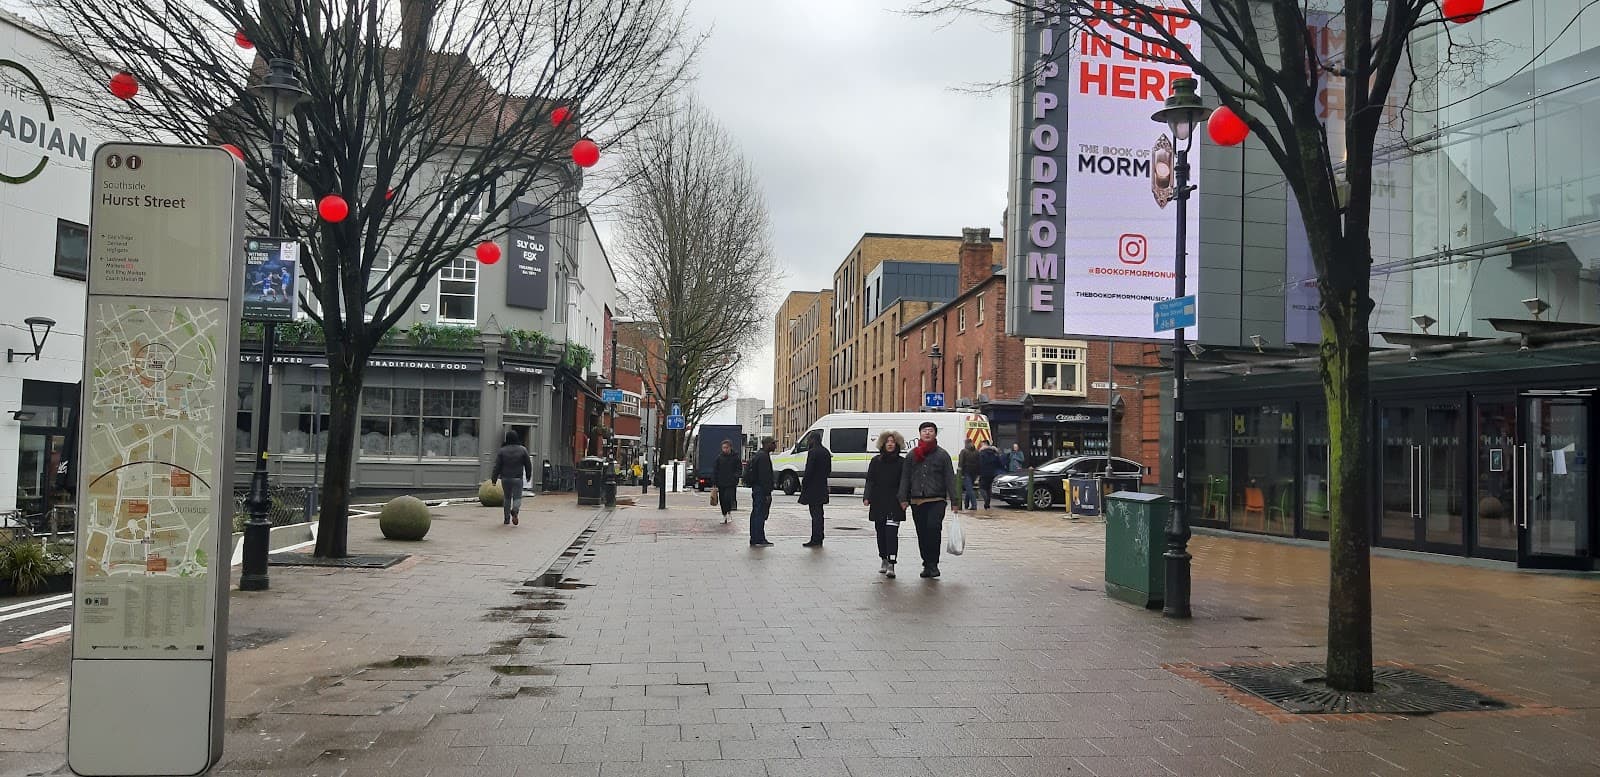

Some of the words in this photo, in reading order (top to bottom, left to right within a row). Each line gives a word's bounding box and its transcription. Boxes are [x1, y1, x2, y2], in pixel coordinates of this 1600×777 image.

[1079, 31, 1112, 59] IN
[4, 84, 26, 103] THE
[0, 109, 87, 161] ADIAN
[1078, 144, 1099, 154] THE
[1102, 146, 1133, 157] BOOK
[1136, 149, 1150, 158] OF
[103, 180, 146, 191] Southside
[102, 193, 140, 207] Hurst
[143, 195, 186, 209] Street
[516, 239, 529, 249] SLY
[529, 242, 545, 252] OLD
[523, 250, 537, 261] FOX
[255, 356, 303, 364] SRCED
[369, 360, 436, 369] TRADITIONAL
